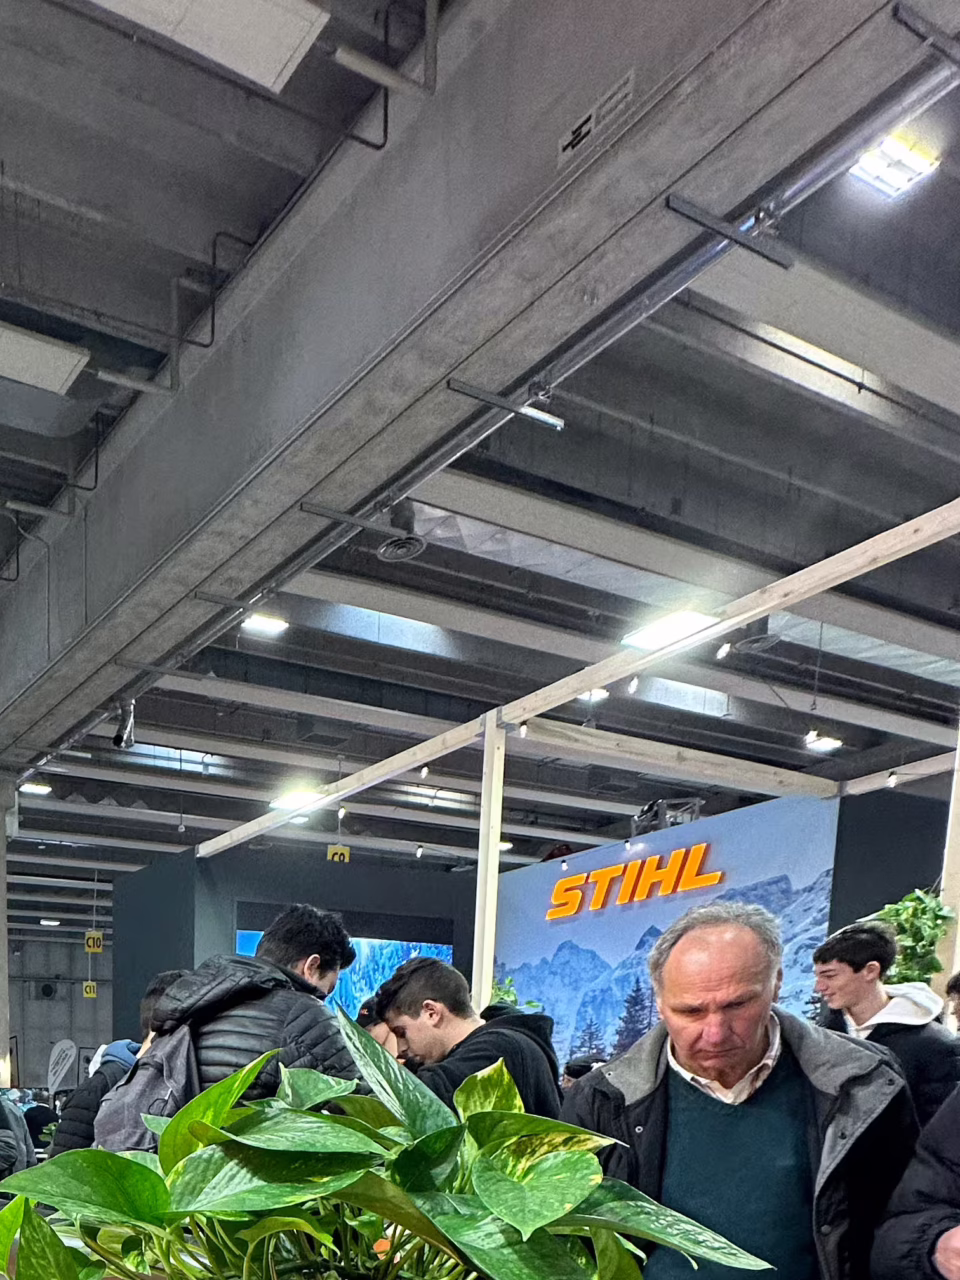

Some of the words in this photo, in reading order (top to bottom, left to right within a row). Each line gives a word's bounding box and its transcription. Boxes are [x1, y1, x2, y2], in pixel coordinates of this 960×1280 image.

[545, 842, 724, 921] STIHL
[86, 936, 102, 949] C10
[84, 984, 96, 995] C11
